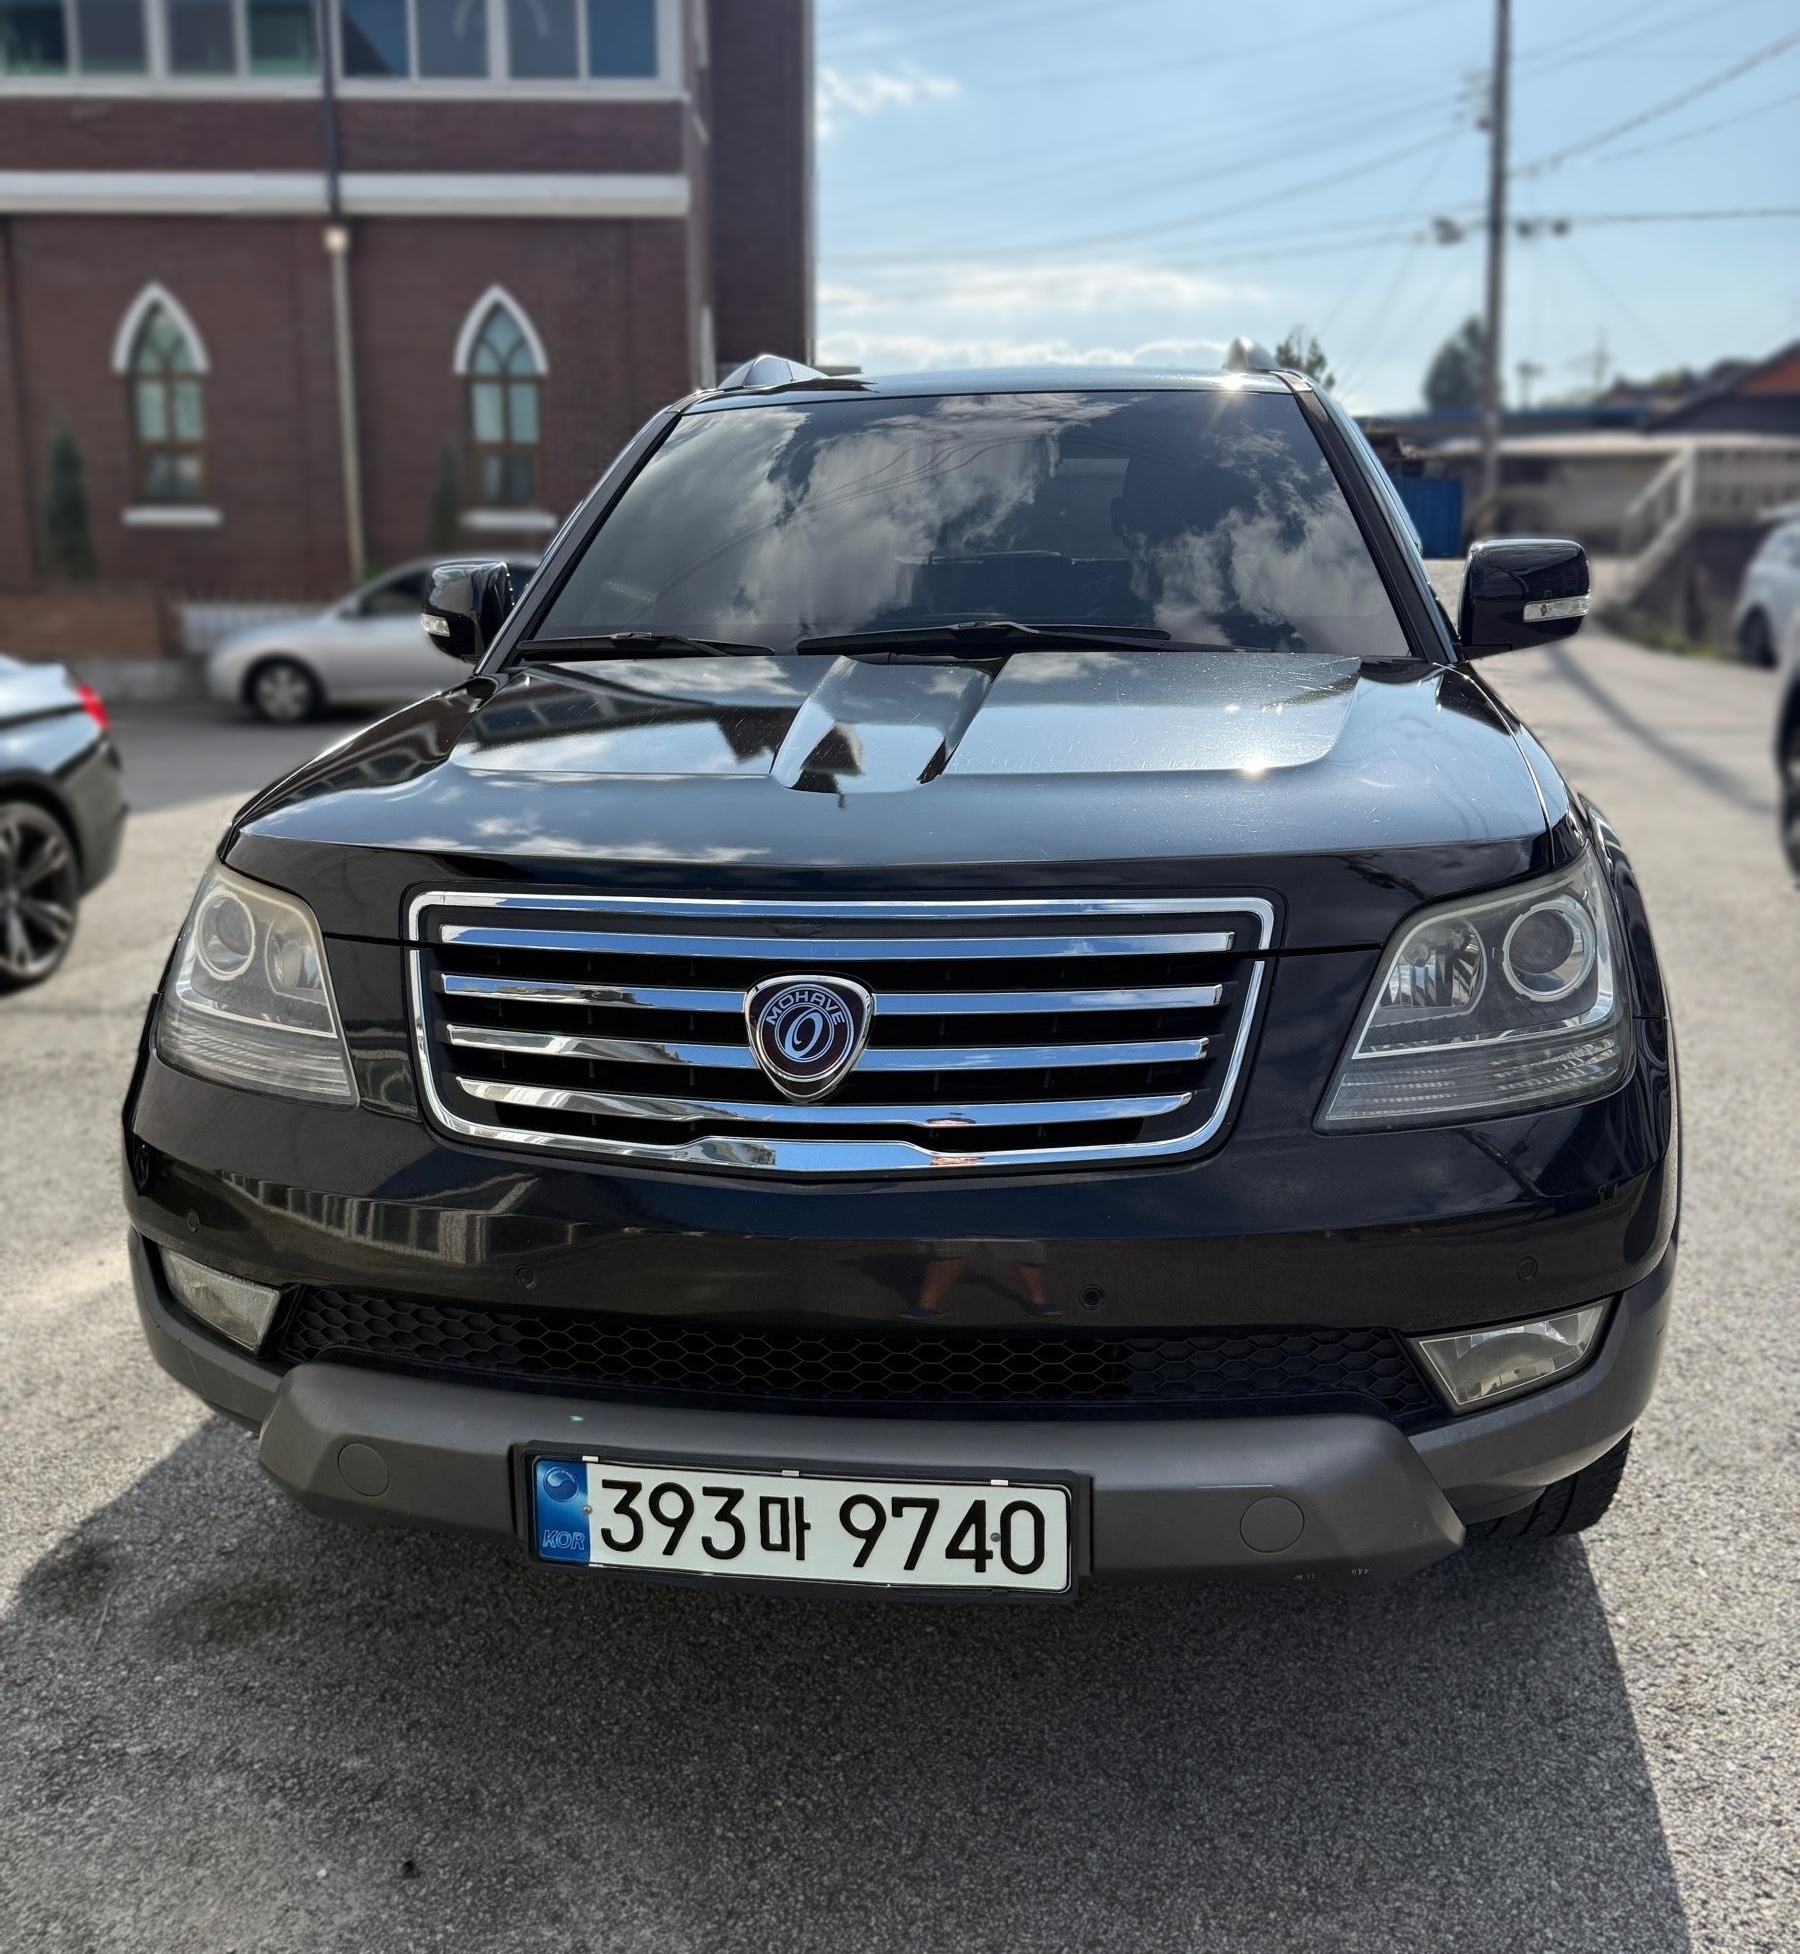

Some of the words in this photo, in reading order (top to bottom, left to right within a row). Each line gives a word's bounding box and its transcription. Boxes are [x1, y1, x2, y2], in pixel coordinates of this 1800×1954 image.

[766, 991, 845, 1026] MOHAVE
[542, 1529, 585, 1550] KOR
[600, 1478, 811, 1561] 393마
[839, 1493, 1045, 1575] 9740
